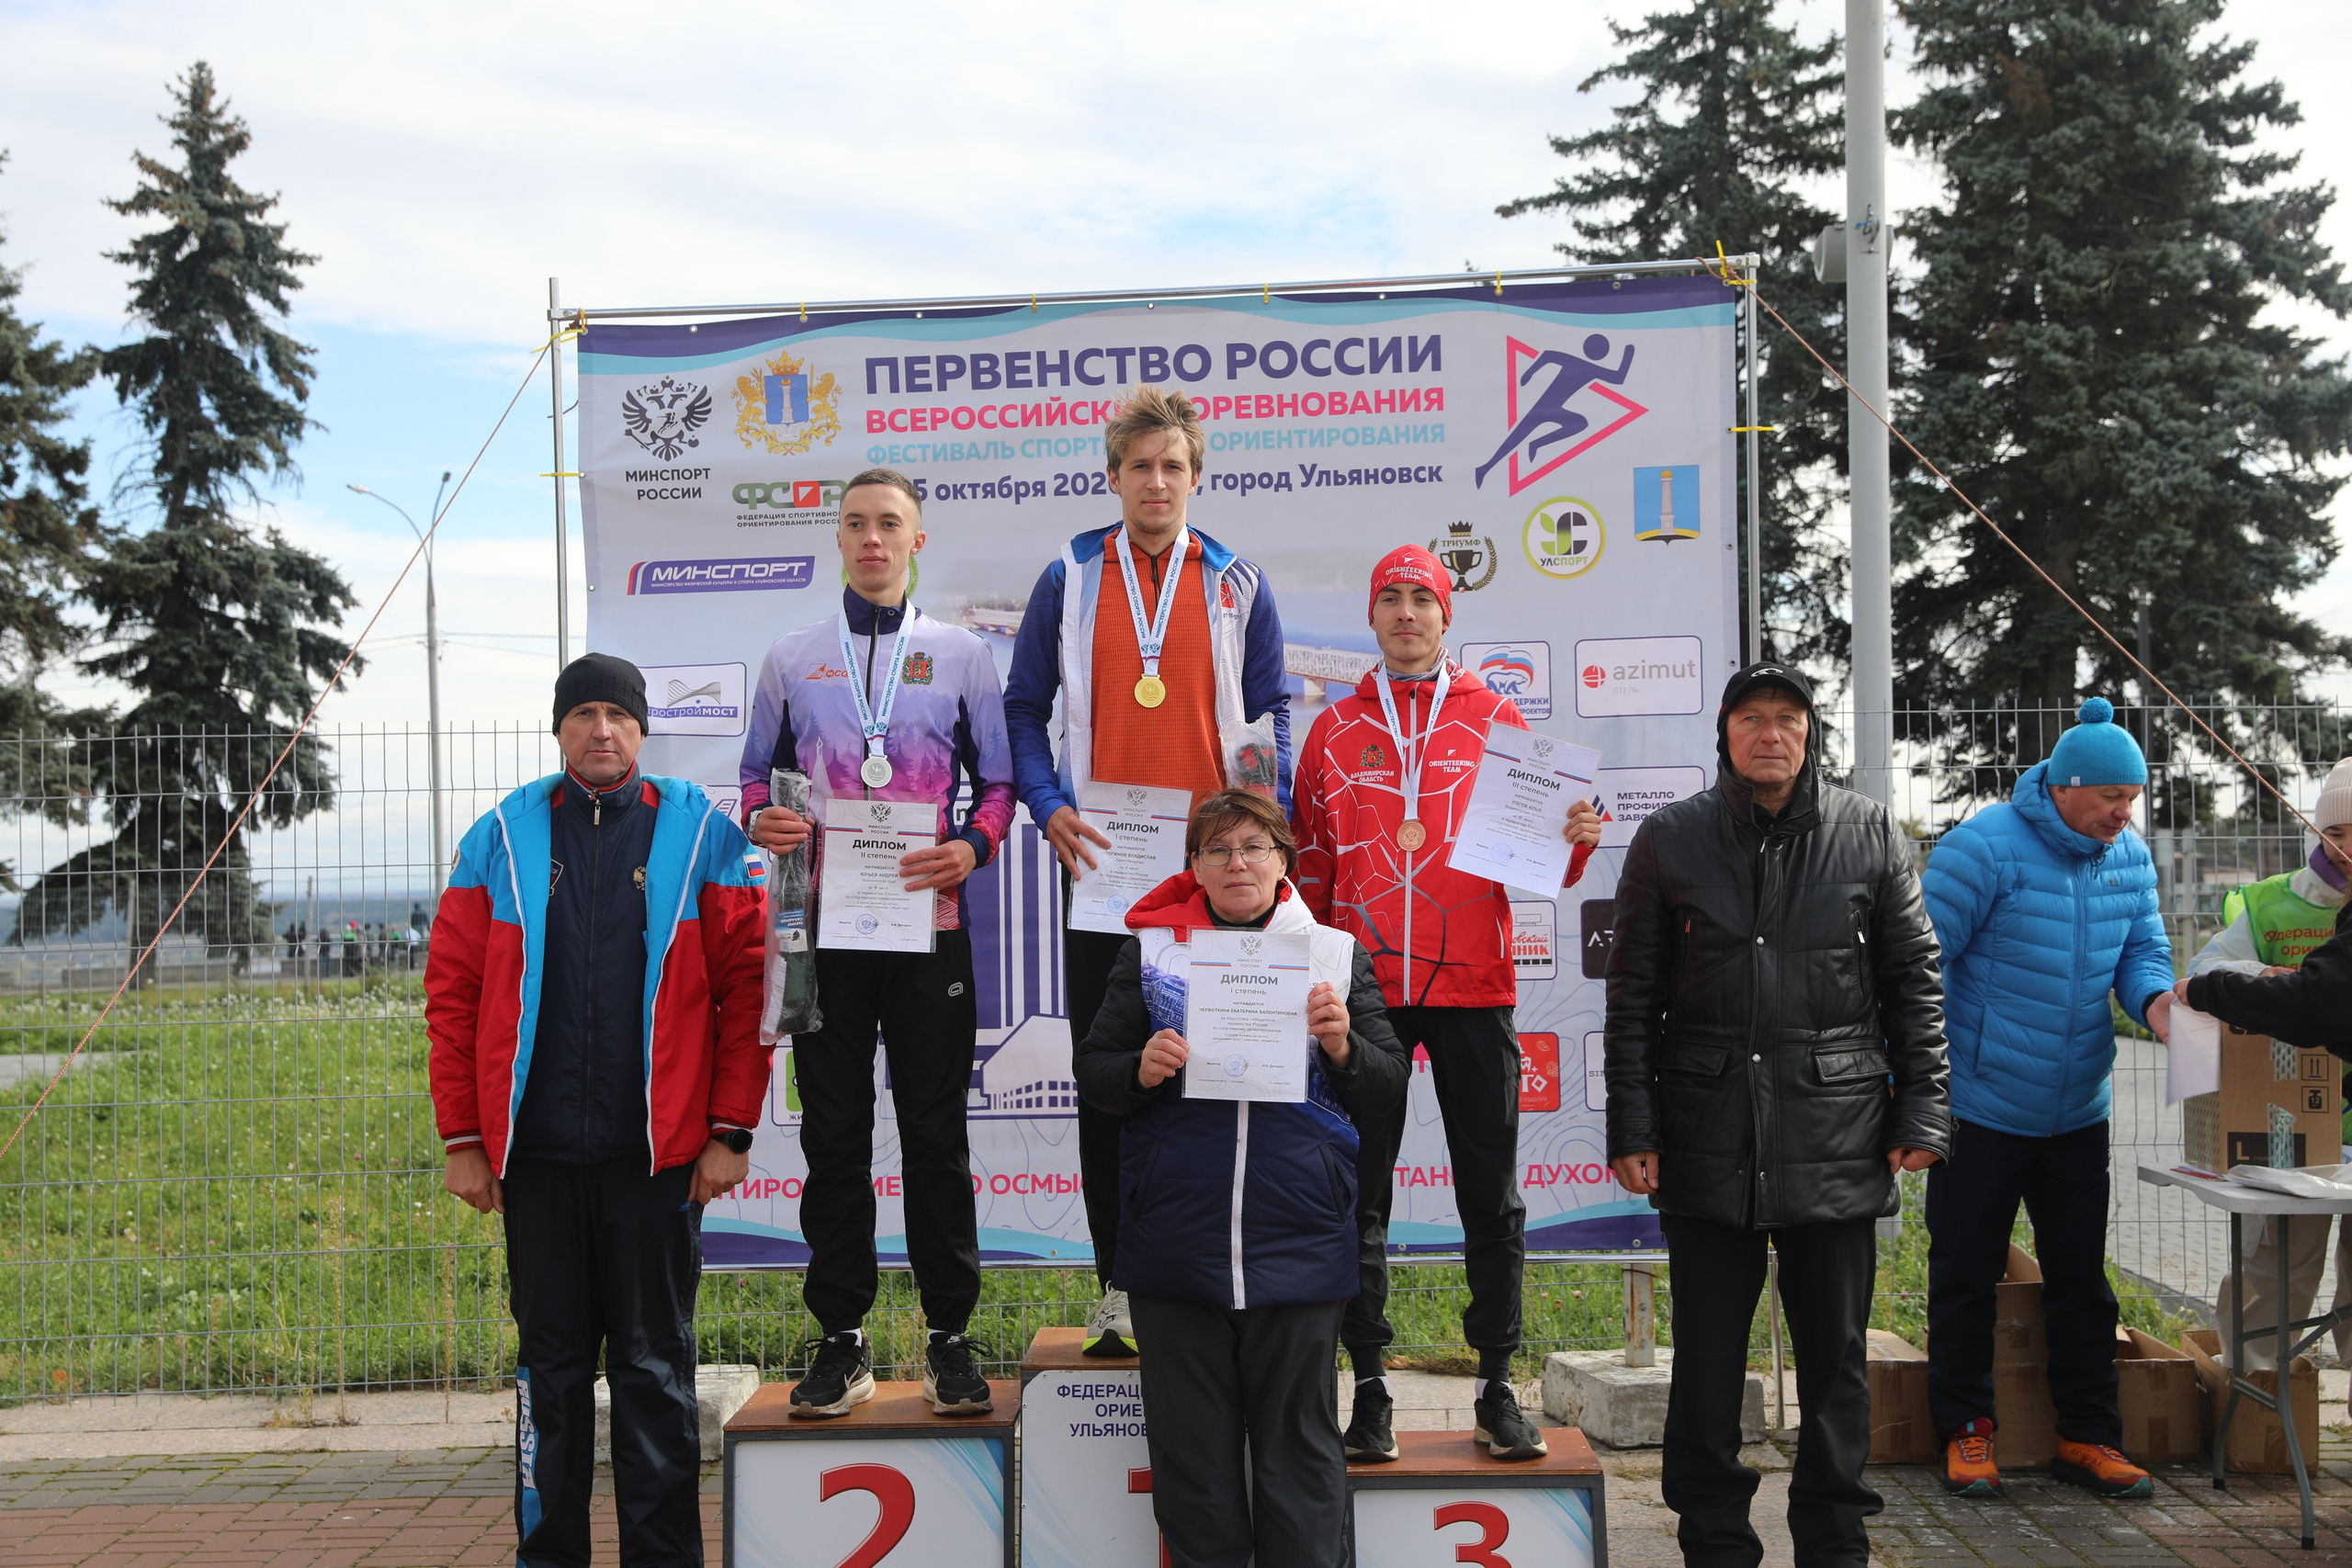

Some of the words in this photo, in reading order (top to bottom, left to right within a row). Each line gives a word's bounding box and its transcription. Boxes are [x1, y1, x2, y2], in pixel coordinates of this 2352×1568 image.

[865, 344, 1212, 395] ПЕРВЕНСТВО
[1226, 334, 1442, 380] РОССИИ
[866, 396, 1134, 434] ВСЕРОССИЙСК
[1190, 387, 1444, 422] ОРЕВНОВАНИЯ
[866, 440, 1015, 467] ФЕСТИВАЛЬ
[1021, 435, 1107, 459] СПОРТ
[1209, 423, 1445, 452] ОРИЕНТИРОВАНИЯ
[626, 468, 711, 483] МИНСПОРТ
[935, 475, 1046, 505] октября
[1211, 471, 1292, 497] город
[1298, 463, 1443, 488] Ульяновск
[637, 487, 702, 501] РОССИИ
[736, 513, 786, 521] ФЕДЕРАЦИЯ
[788, 511, 840, 519] СПОРТИВНО
[737, 520, 812, 528] ОРИЕНТИРОВАНИЯ
[1441, 538, 1481, 548] ТРИУМФ
[651, 562, 807, 581] МИНСПОРТ
[1385, 565, 1434, 581] ORIENTEERING
[1400, 572, 1421, 581] TEAM
[1123, 556, 1136, 596] МИНИСТЕРСТВО
[1132, 595, 1141, 616] СПОРТА
[1137, 617, 1147, 638] РОССИИ
[1155, 598, 1169, 638] МИНИСТЕРСТВО
[1165, 578, 1174, 598] СПОРТА
[1170, 557, 1180, 578] РОССИИ
[881, 676, 895, 716] МИНИСТЕРСТВО
[891, 657, 899, 676] СПОРТА
[896, 636, 905, 657] РОССИИ
[1612, 659, 1697, 682] azimut
[844, 641, 857, 679] МИНИСТЕРСТВО
[853, 679, 862, 699] СПОРТА
[858, 698, 868, 721] РОССИИ
[1612, 686, 1640, 694] ОТЕЛЬ
[1513, 697, 1549, 706] ДЕРЖКИ
[1429, 760, 1476, 768] ORIENTEERING
[1507, 768, 1561, 791] ДИПЛОМ
[1520, 784, 1549, 798] степень
[1617, 791, 1675, 800] МЕТАЛЛО
[1106, 821, 1159, 834] ДИПЛОМ
[853, 839, 907, 852] ДИПЛОМ
[1118, 835, 1148, 843] степень
[1220, 974, 1278, 986] ДИПЛОМ
[2236, 1141, 2250, 1160] L
[989, 1173, 1083, 1196] ОСМЫ
[1057, 1383, 1141, 1401] ФЕДЕРАЦ
[1095, 1404, 1143, 1417] ОРИЕ
[516, 1379, 537, 1490] RUSSIA
[820, 1462, 916, 1568] 2
